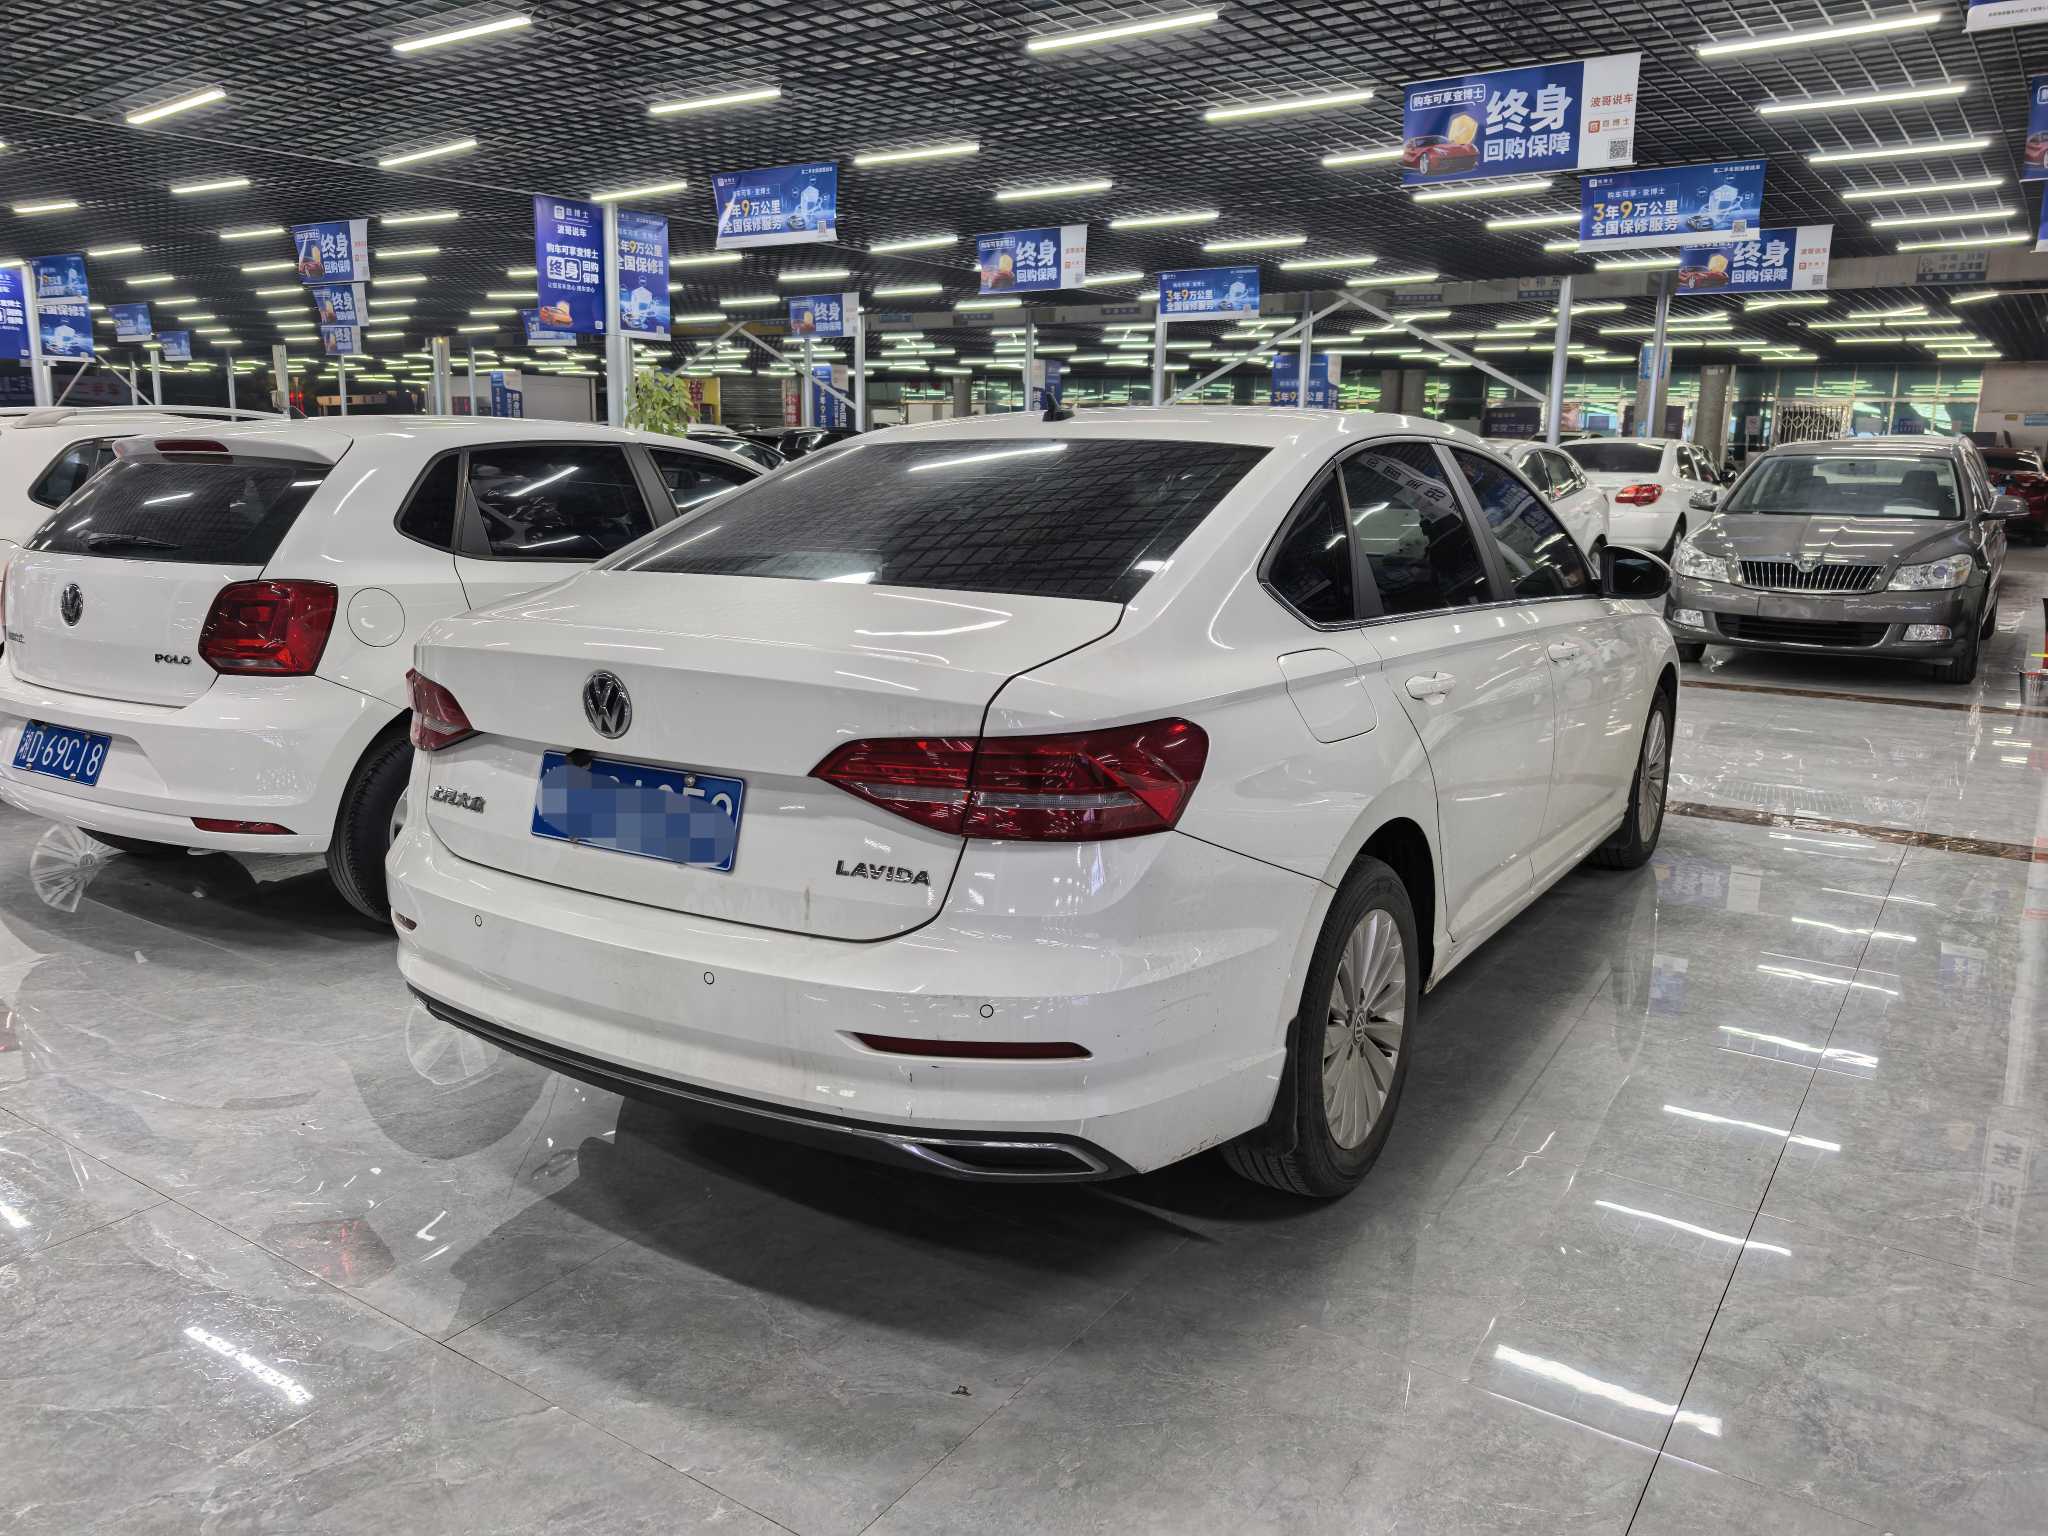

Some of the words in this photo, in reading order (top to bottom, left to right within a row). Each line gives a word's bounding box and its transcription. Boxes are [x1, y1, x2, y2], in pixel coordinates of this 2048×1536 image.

[1412, 88, 1484, 109] 购车可享查博士
[1590, 93, 1634, 109] 波哥说车
[1485, 83, 1573, 135] 终身
[1483, 132, 1571, 163] 回购保障
[1592, 199, 1678, 222] 3年9万公里
[723, 215, 782, 234] 全国保修服务
[1591, 215, 1680, 237] 全国保修服务
[321, 232, 349, 259] 终身
[1016, 239, 1056, 267] 终身
[1733, 239, 1790, 269] 终身
[549, 259, 579, 279] 终身
[582, 260, 599, 273] 回购
[1016, 267, 1057, 283] 回购保障
[1731, 267, 1788, 284] 回购保障
[332, 291, 353, 310] 终身
[1165, 289, 1213, 302] 3年9万公里
[815, 302, 840, 321] 终身
[154, 653, 192, 666] POLO
[836, 859, 930, 886] LAVIDA
